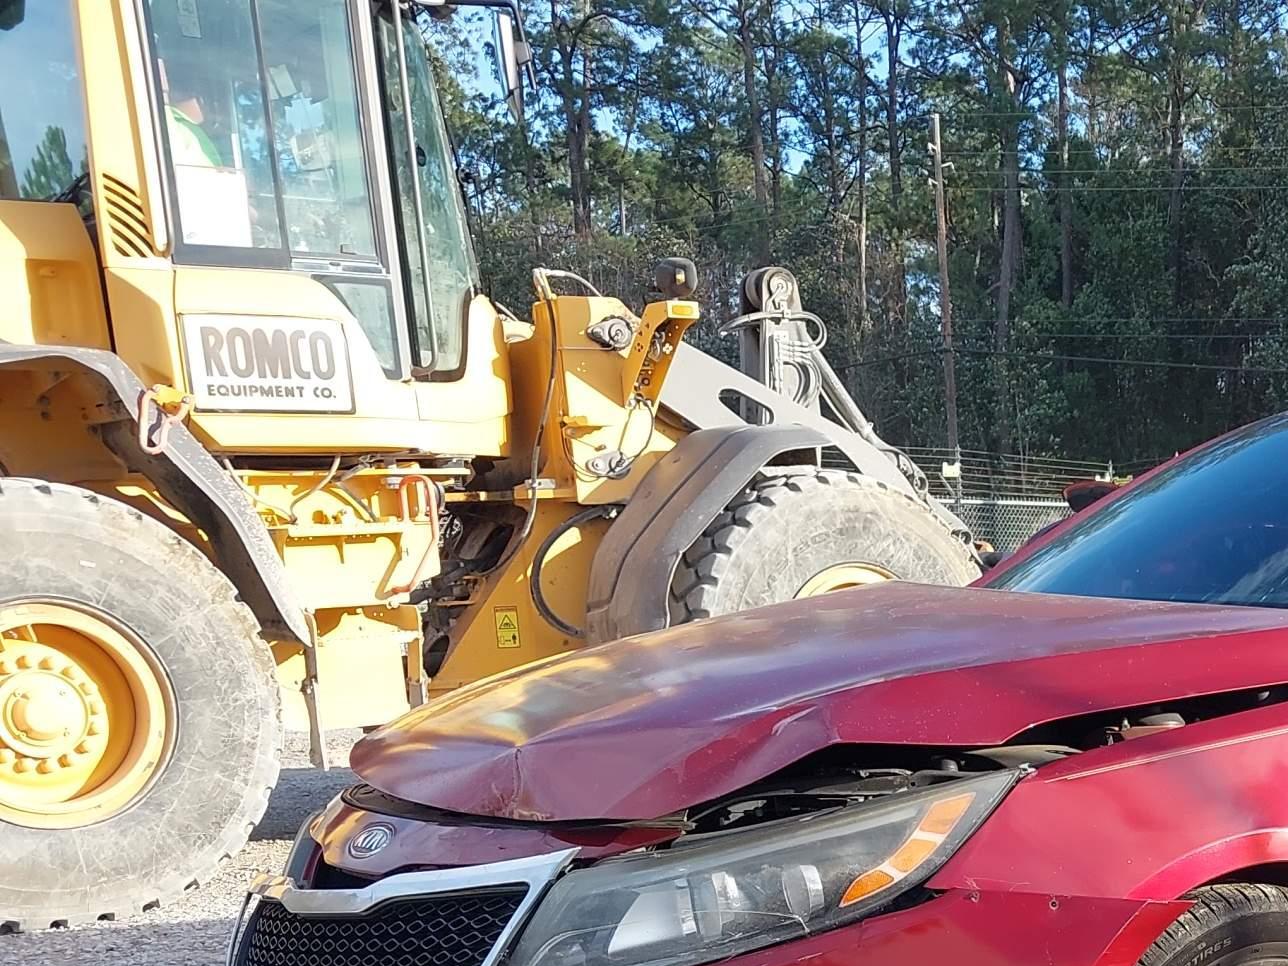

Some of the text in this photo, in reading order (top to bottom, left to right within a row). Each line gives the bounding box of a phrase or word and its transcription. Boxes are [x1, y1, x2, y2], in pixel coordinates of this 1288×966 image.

[200, 326, 335, 380] ROMCO
[207, 384, 337, 399] EQUIPMENT CO.
